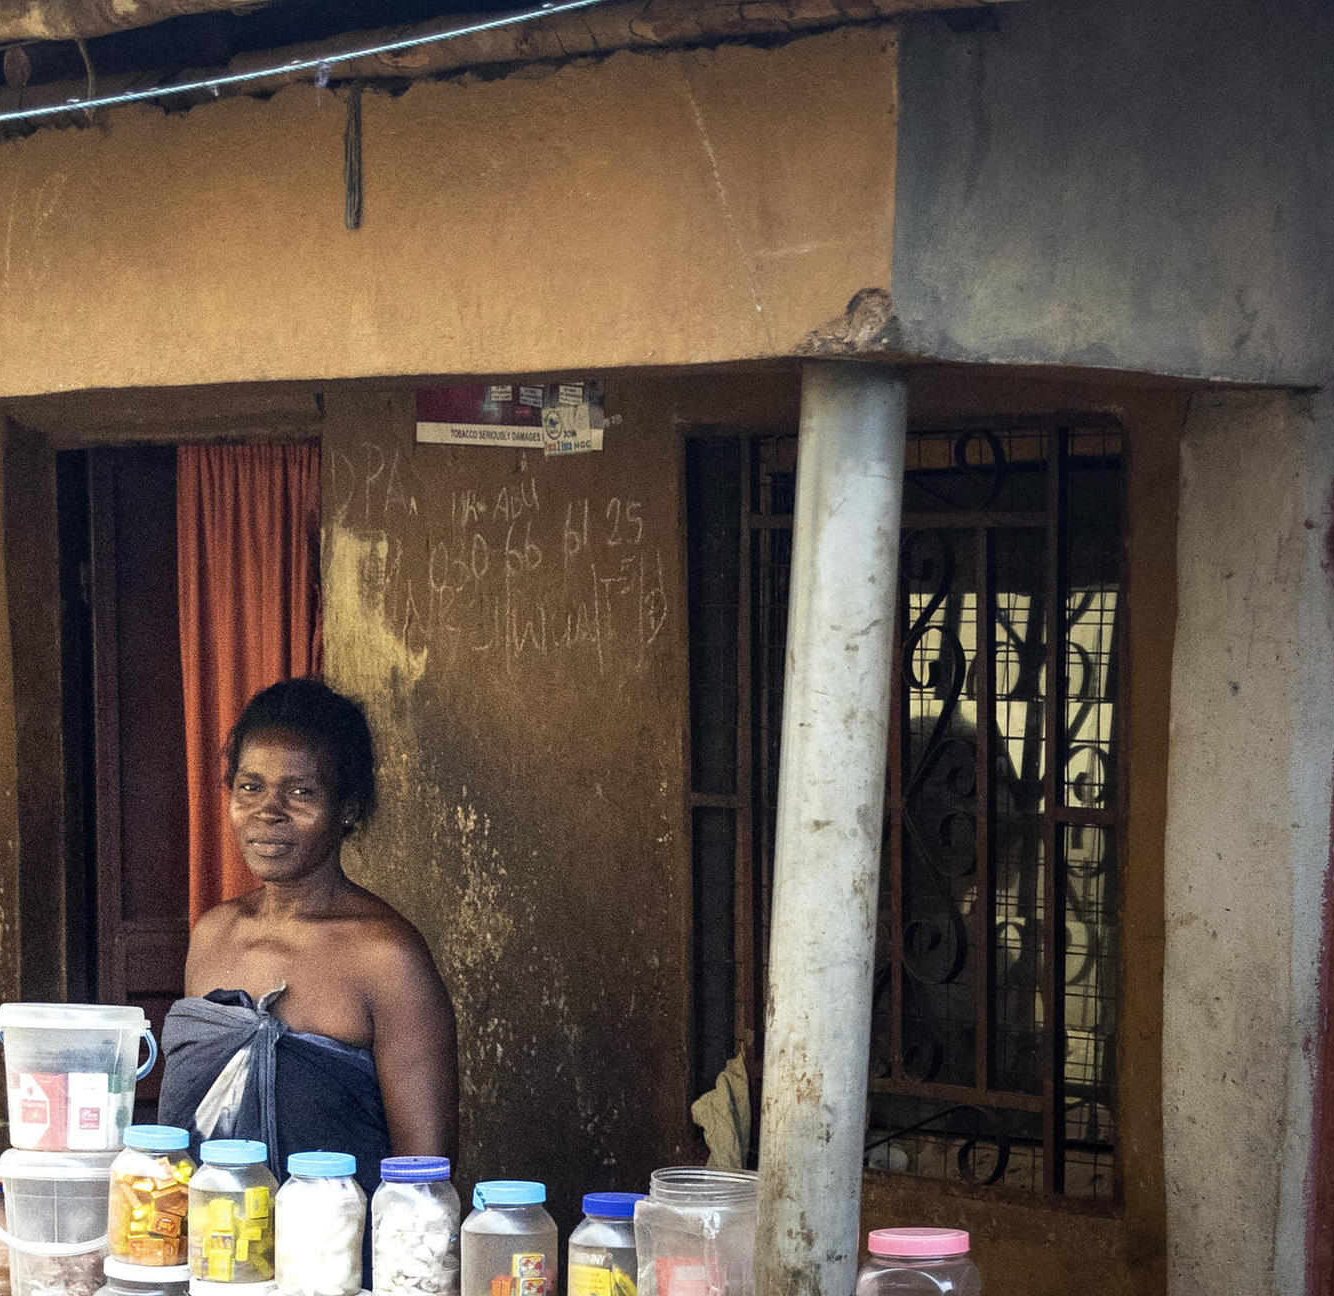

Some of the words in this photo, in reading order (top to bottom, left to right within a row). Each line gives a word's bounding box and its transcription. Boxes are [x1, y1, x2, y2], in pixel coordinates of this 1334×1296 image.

[450, 428, 478, 440] TOBACCO
[478, 430, 511, 441] SERIOUSLY
[512, 431, 540, 442] DAMAGES
